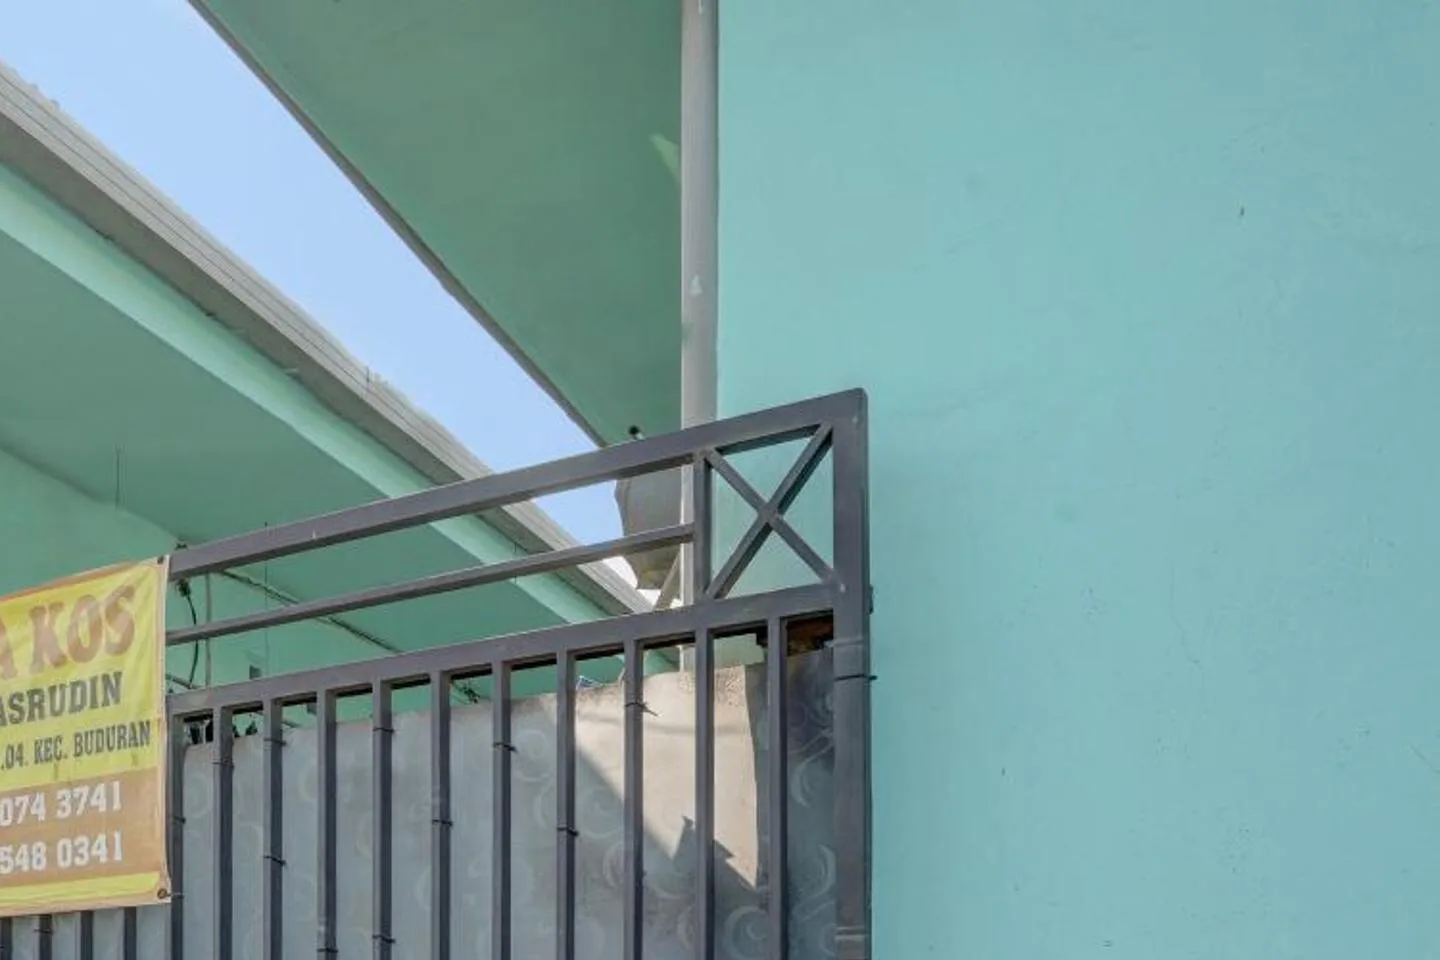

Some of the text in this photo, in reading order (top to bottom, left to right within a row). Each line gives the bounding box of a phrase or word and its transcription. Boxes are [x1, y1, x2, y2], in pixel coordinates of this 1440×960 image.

[29, 587, 136, 669] KOS
[33, 736, 69, 764] KEC.
[73, 720, 151, 758] BUDURAN
[56, 780, 123, 819] 3741
[56, 831, 123, 868] 0341
